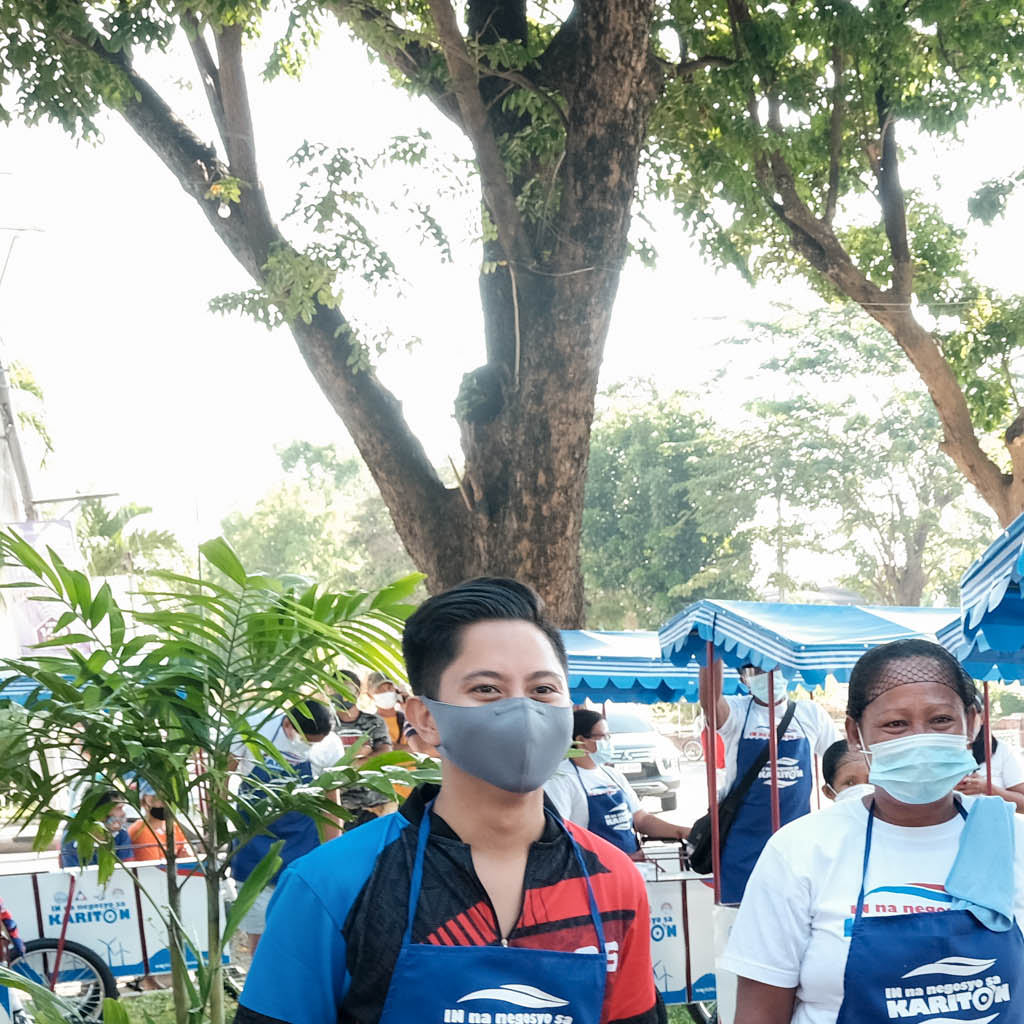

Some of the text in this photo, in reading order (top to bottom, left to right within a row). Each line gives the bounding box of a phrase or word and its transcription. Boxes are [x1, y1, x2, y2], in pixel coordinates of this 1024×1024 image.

[876, 904, 897, 913] na
[903, 905, 951, 913] nego
[885, 975, 1002, 998] IN na negosyo sa
[886, 983, 1011, 1018] KARITON
[444, 1009, 465, 1024] IN
[468, 1012, 491, 1024] na
